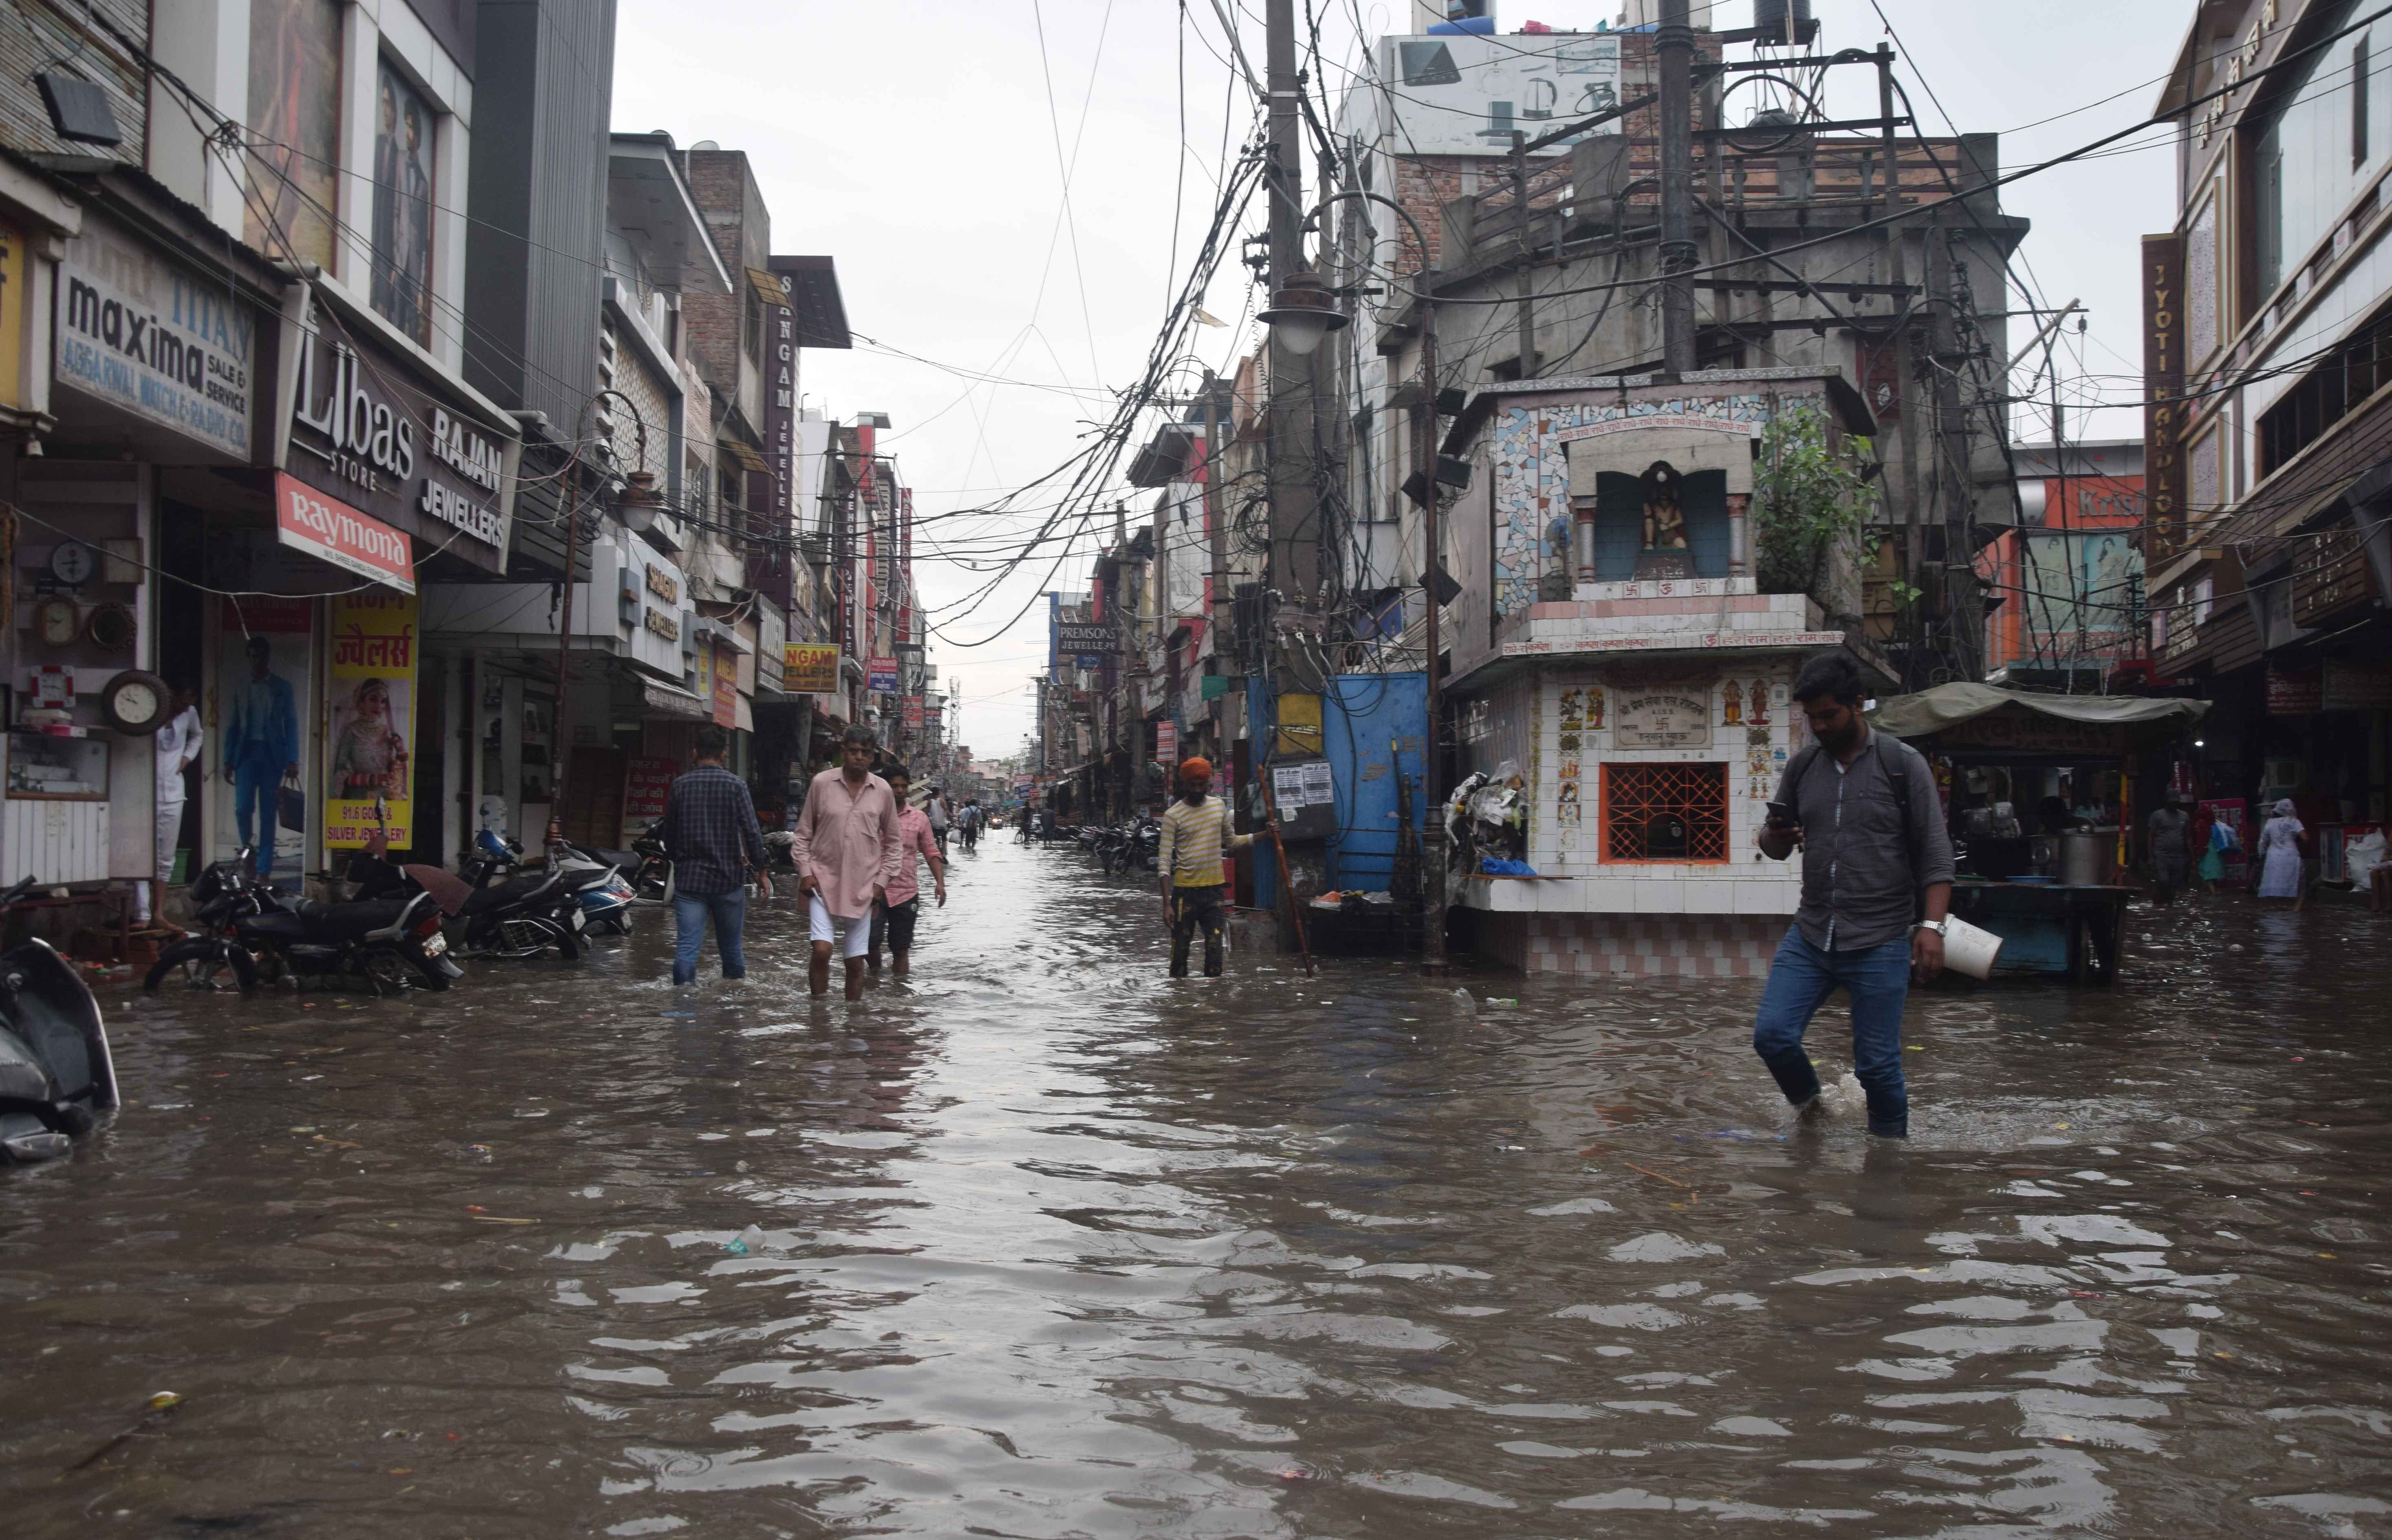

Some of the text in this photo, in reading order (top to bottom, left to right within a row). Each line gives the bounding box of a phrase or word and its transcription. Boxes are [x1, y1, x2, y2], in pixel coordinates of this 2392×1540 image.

[68, 276, 204, 394] maxima
[208, 354, 235, 384] SALE
[207, 380, 245, 415] SERVICE
[296, 327, 414, 481] Libas
[2154, 265, 2173, 557] JYOTI HANDLOOM
[433, 408, 502, 494] RAJAN
[329, 451, 377, 491] STORE
[290, 491, 406, 566] Raymond
[421, 478, 504, 549] JEWELLERS
[1060, 628, 1116, 639] PREMSONS
[1062, 641, 1116, 651] JEWELLERS
[1527, 642, 1551, 653] कृष्ण
[1577, 641, 1599, 651] कृष्ण
[1602, 639, 1624, 650] कृष्ण
[1626, 638, 1650, 649] कृष्ण
[1747, 635, 1768, 645] राम
[1795, 634, 1819, 643] राम
[786, 649, 833, 665] NGAM
[343, 806, 392, 820] 91.6 GOL &
[328, 826, 407, 842] SILVER JEWELERY
